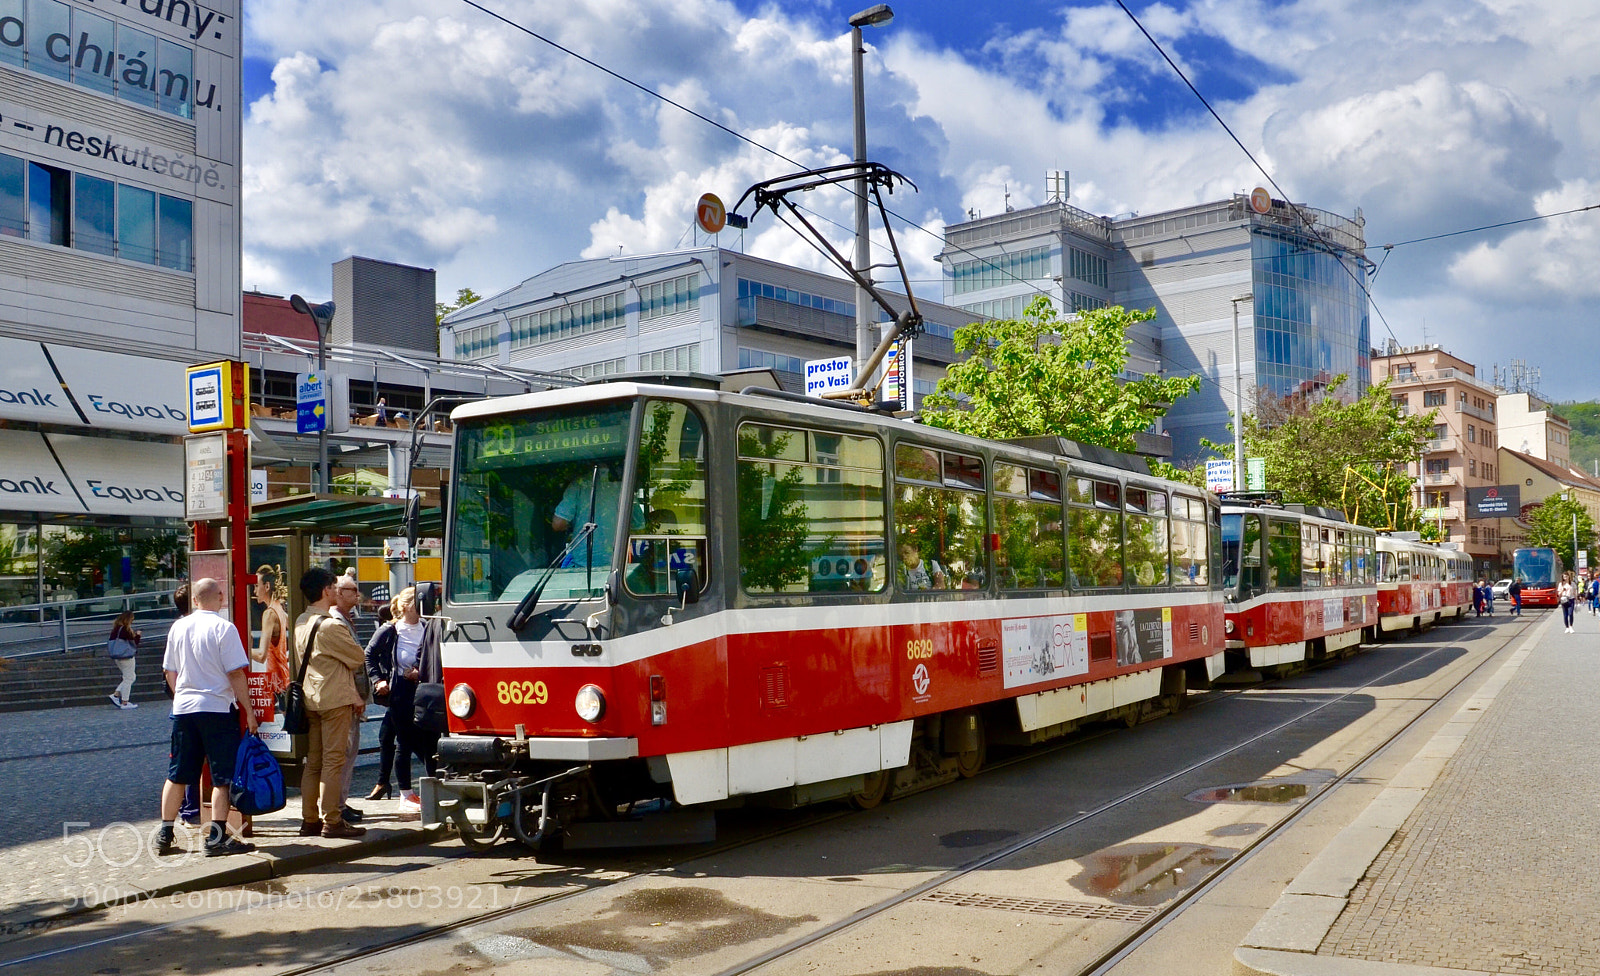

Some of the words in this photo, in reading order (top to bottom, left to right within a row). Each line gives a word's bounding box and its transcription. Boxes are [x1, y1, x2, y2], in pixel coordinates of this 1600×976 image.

[45, 31, 222, 112] chrámu.
[45, 124, 226, 190] neskutečně.
[807, 360, 849, 378] prostor
[299, 380, 323, 392] albert
[808, 380, 825, 392] pro
[827, 373, 849, 387] Vaši
[0, 388, 59, 408] ank
[482, 425, 516, 456] 20
[524, 432, 611, 452] Barrandov
[0, 476, 62, 495] ank
[907, 639, 933, 660] 8629
[257, 698, 272, 707] TEXT
[497, 681, 548, 705] 8629
